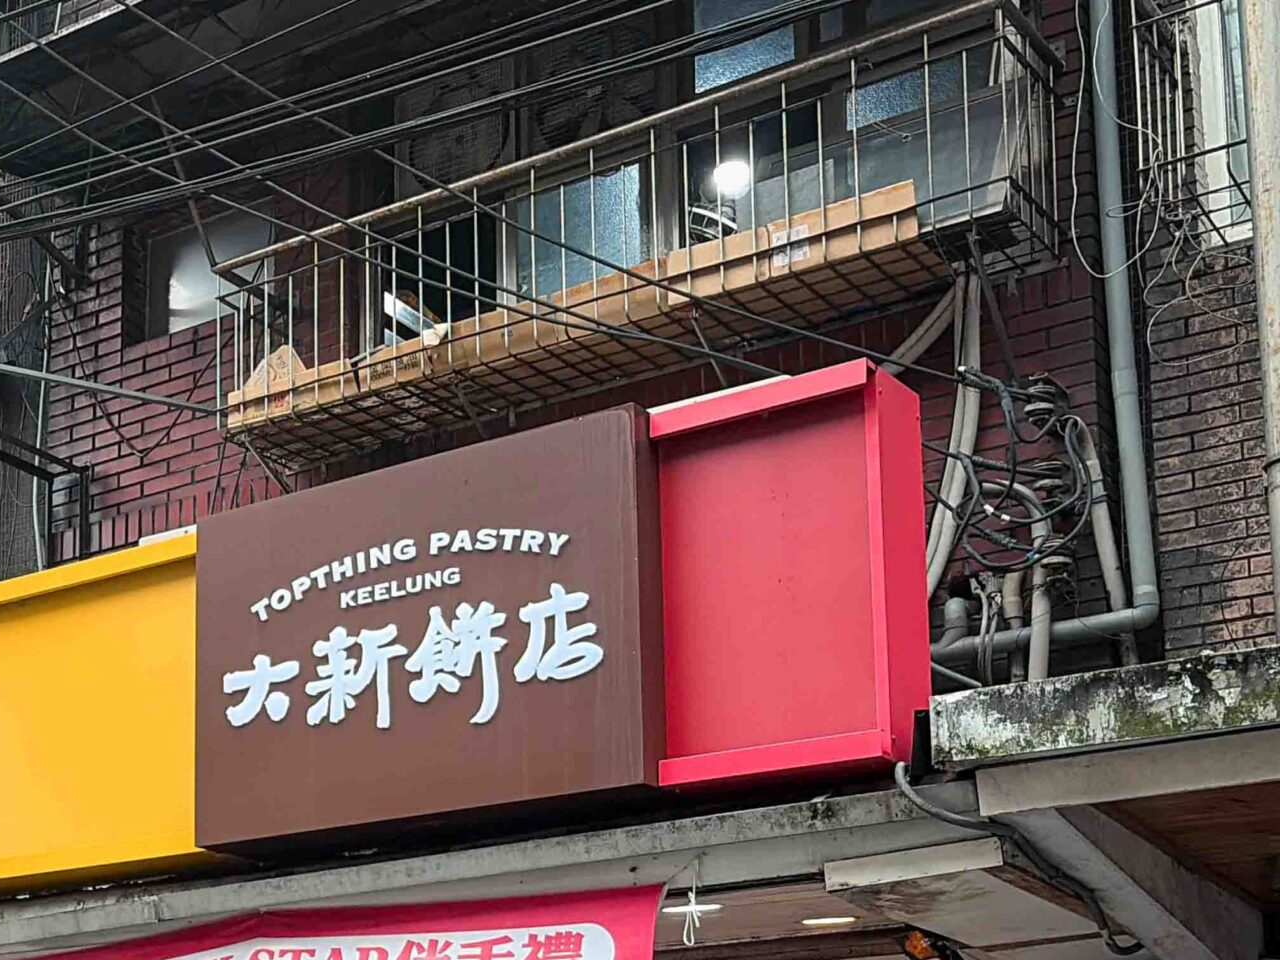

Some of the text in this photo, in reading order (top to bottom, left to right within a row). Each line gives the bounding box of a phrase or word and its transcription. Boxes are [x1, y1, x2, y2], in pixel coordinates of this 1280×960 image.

[250, 528, 570, 622] TOPTHING PASTRY
[340, 567, 461, 609] KEELUNG
[223, 583, 605, 729] 大新餅店
